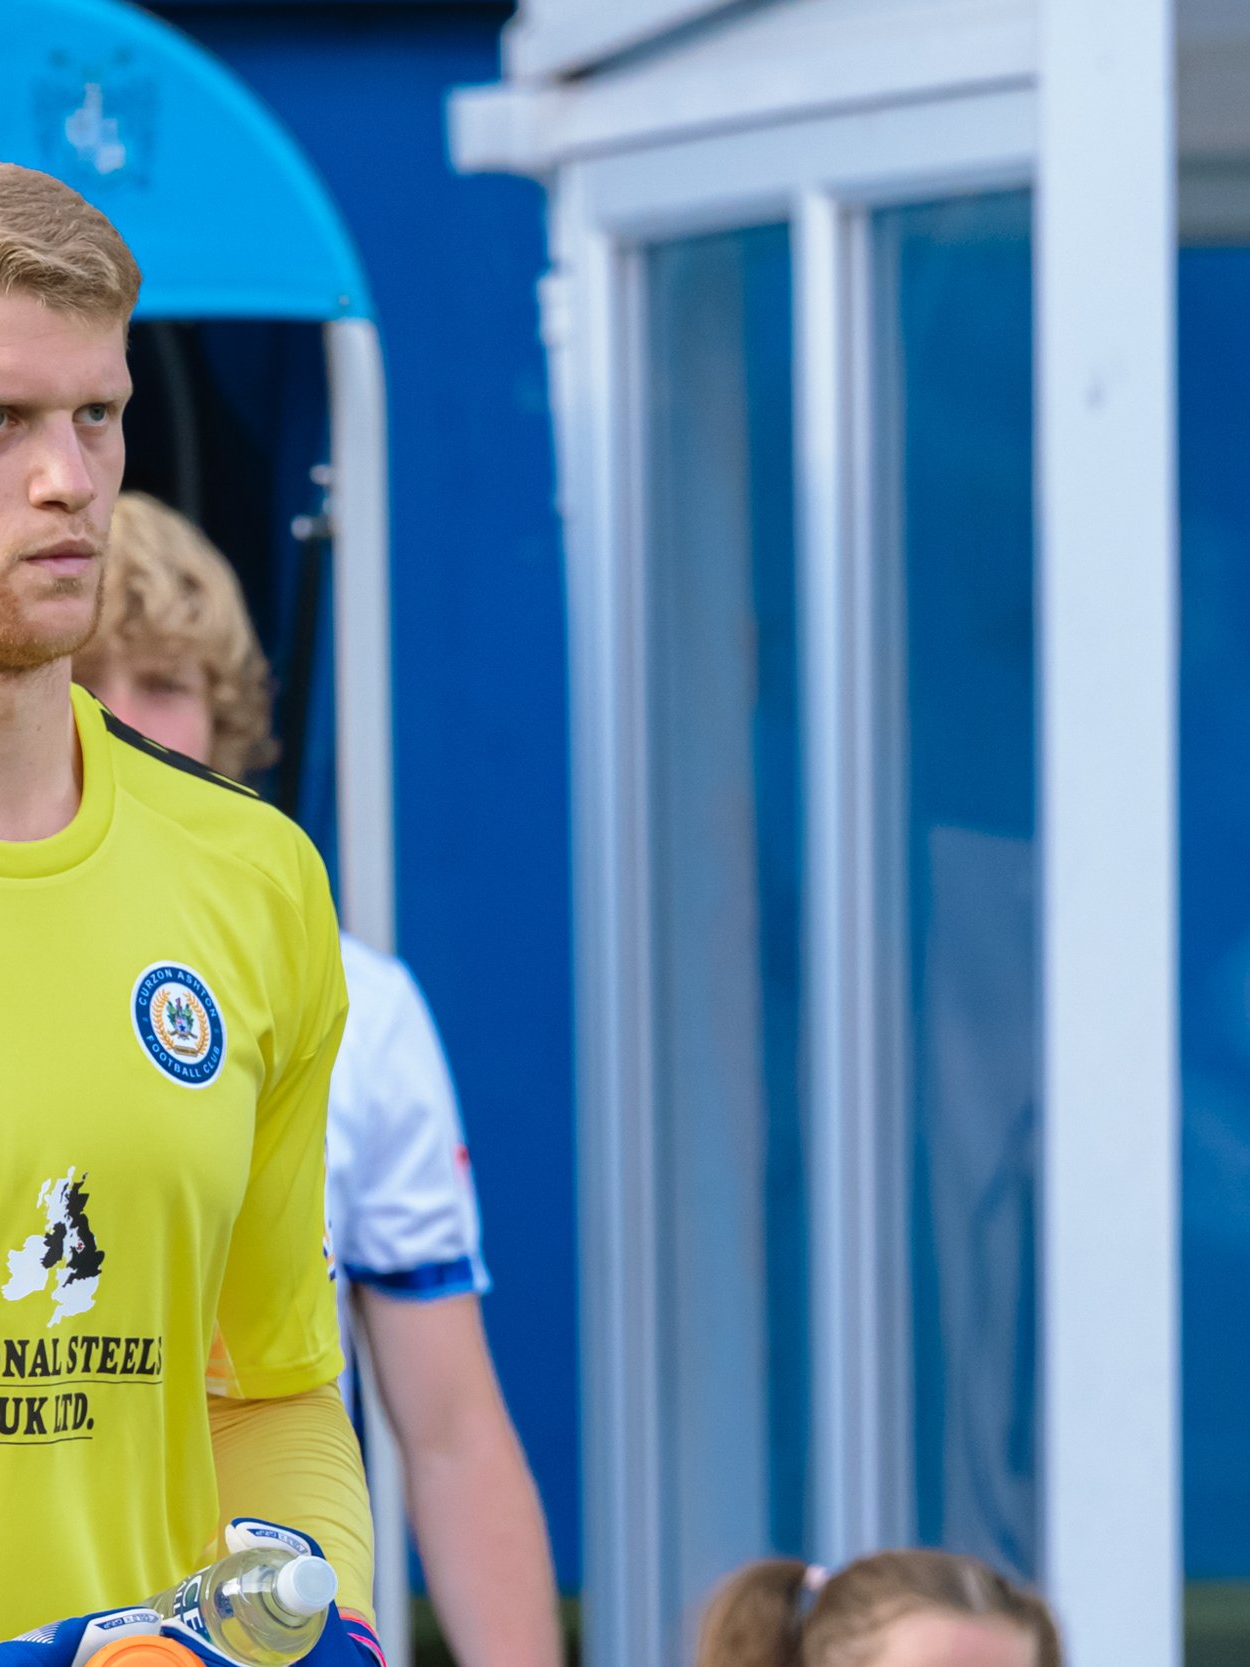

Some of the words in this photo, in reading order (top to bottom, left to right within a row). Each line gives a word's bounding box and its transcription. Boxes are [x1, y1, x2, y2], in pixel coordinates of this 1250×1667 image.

[138, 969, 173, 1006] CURZON
[177, 970, 217, 1017] ASHTON
[145, 1034, 202, 1078] FOOTBALL
[203, 1045, 220, 1074] CLUB
[52, 1392, 95, 1434] LTD.
